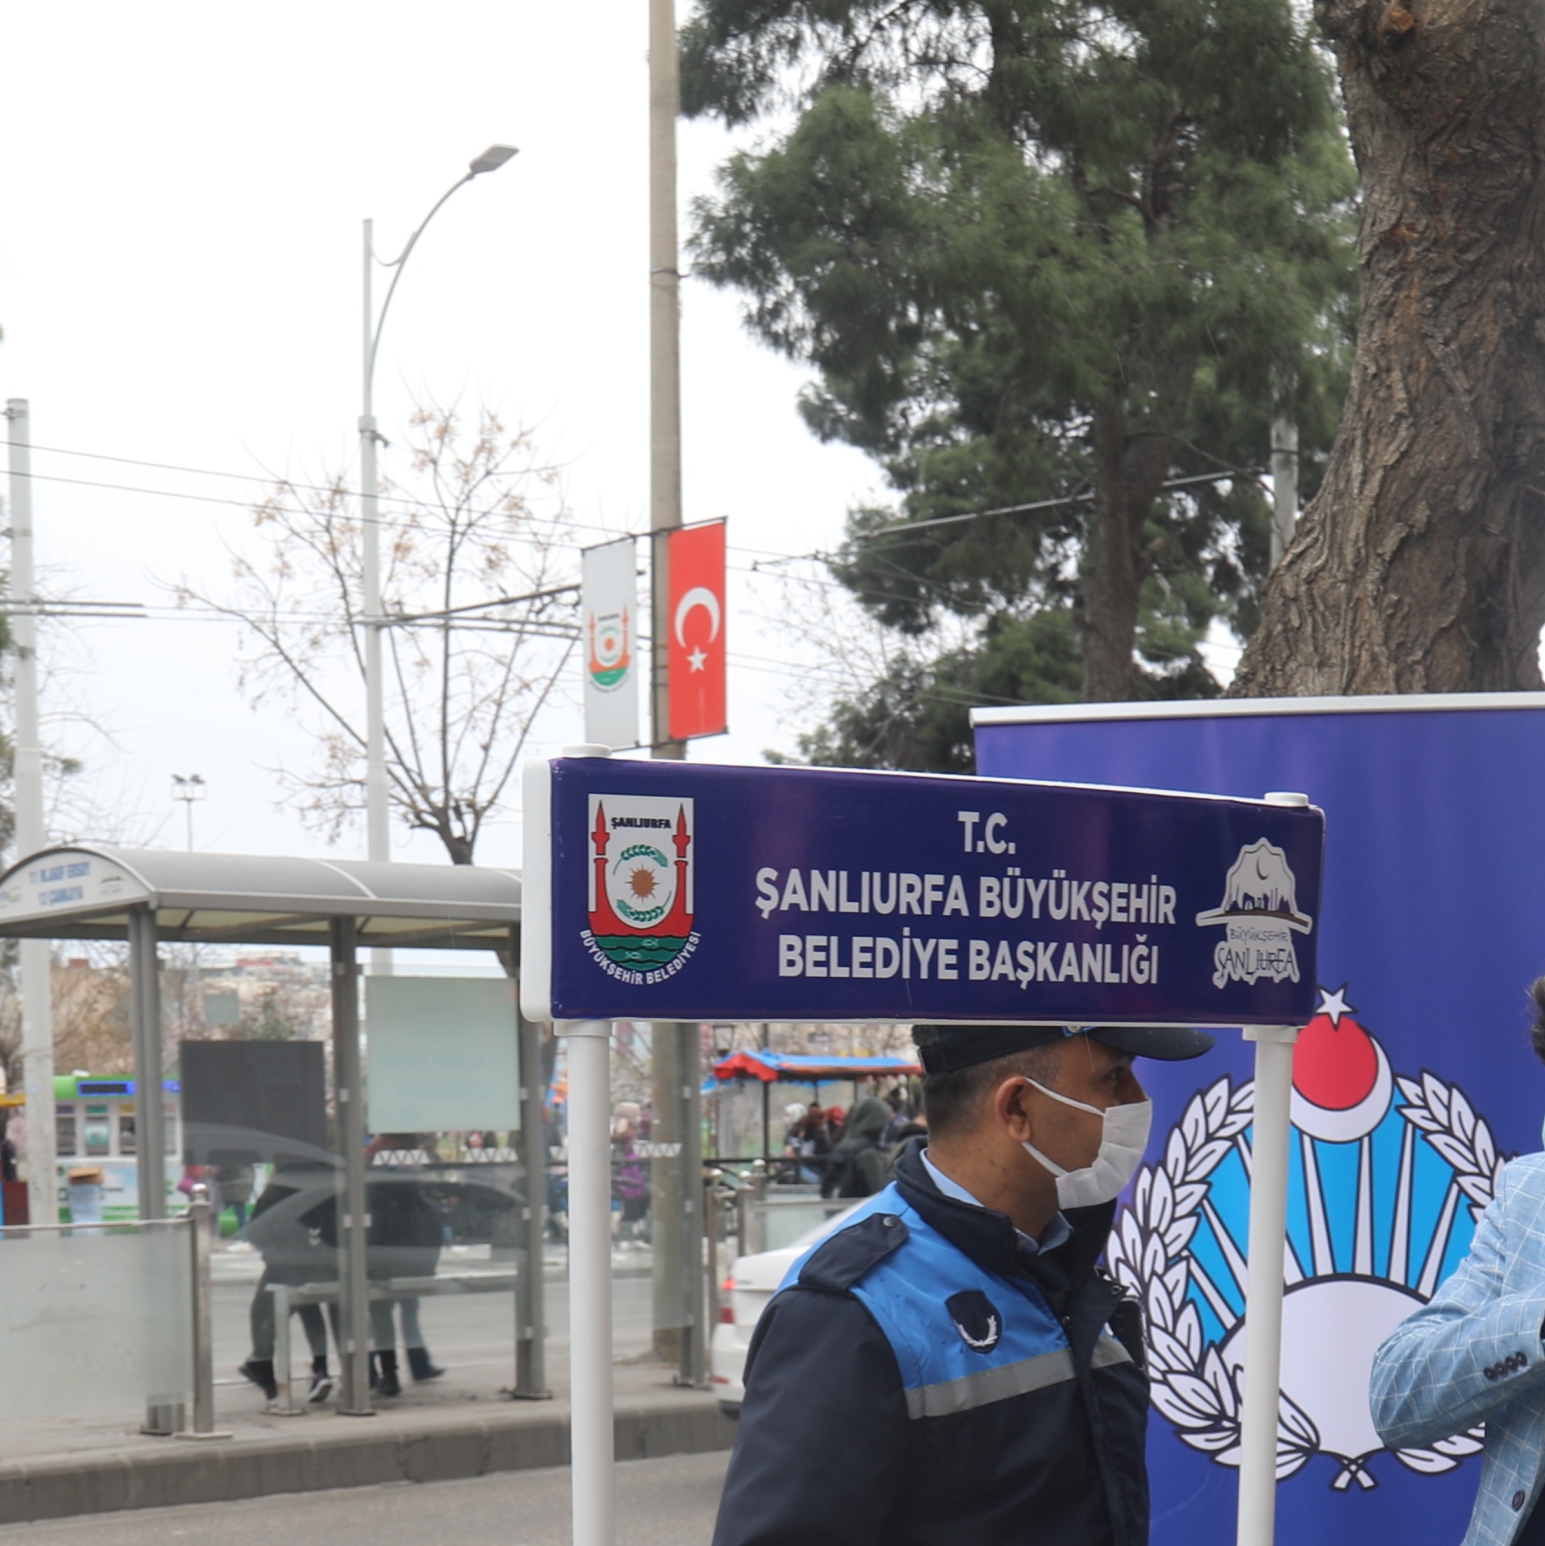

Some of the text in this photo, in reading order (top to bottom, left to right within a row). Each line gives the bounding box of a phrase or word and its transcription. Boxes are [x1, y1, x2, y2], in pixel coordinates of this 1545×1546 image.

[611, 817, 671, 830] ŞANLIURFA
[958, 810, 1017, 855] T.C.
[755, 867, 1177, 931] ŞANLIURFA BÜYÜKŞEHİR
[580, 929, 702, 985] BÜYÜKŞEHİR BELEDİYESİ
[778, 927, 1159, 990] BELEDİYE BAŞKANLIĞI
